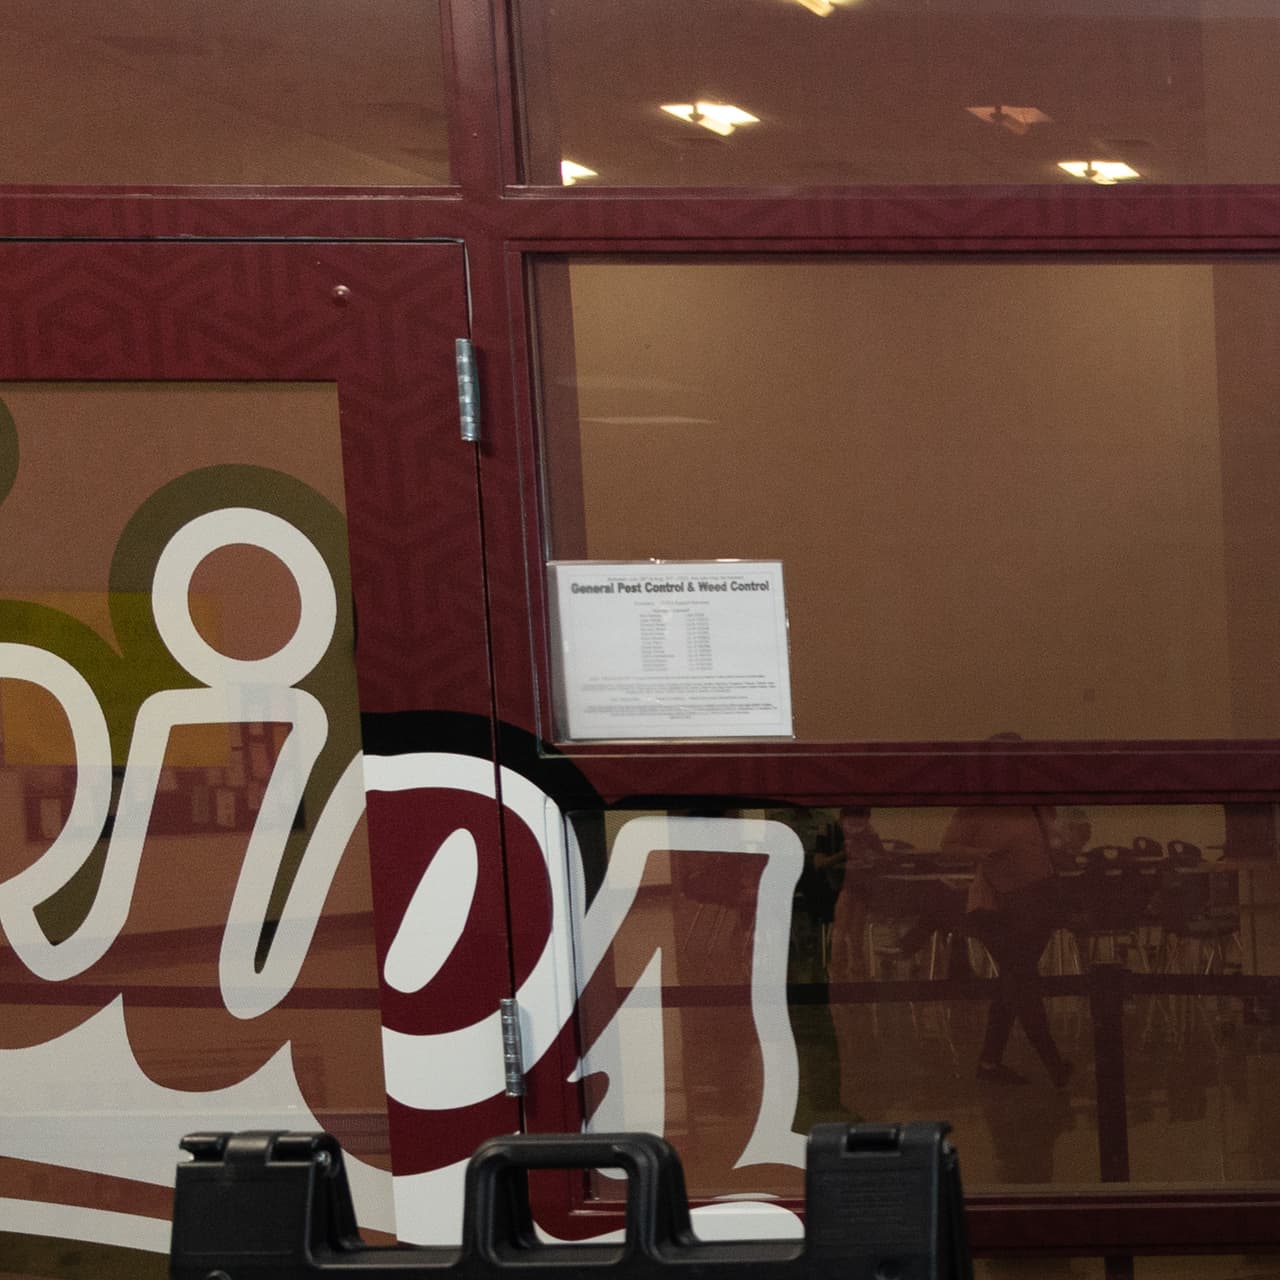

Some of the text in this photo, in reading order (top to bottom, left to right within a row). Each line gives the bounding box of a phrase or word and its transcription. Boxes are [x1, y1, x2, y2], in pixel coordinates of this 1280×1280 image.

[571, 582, 614, 594] General
[618, 581, 642, 593] Pest
[645, 581, 684, 593] Control
[688, 581, 696, 592] &
[699, 580, 727, 592] Weed
[731, 579, 770, 591] Control
